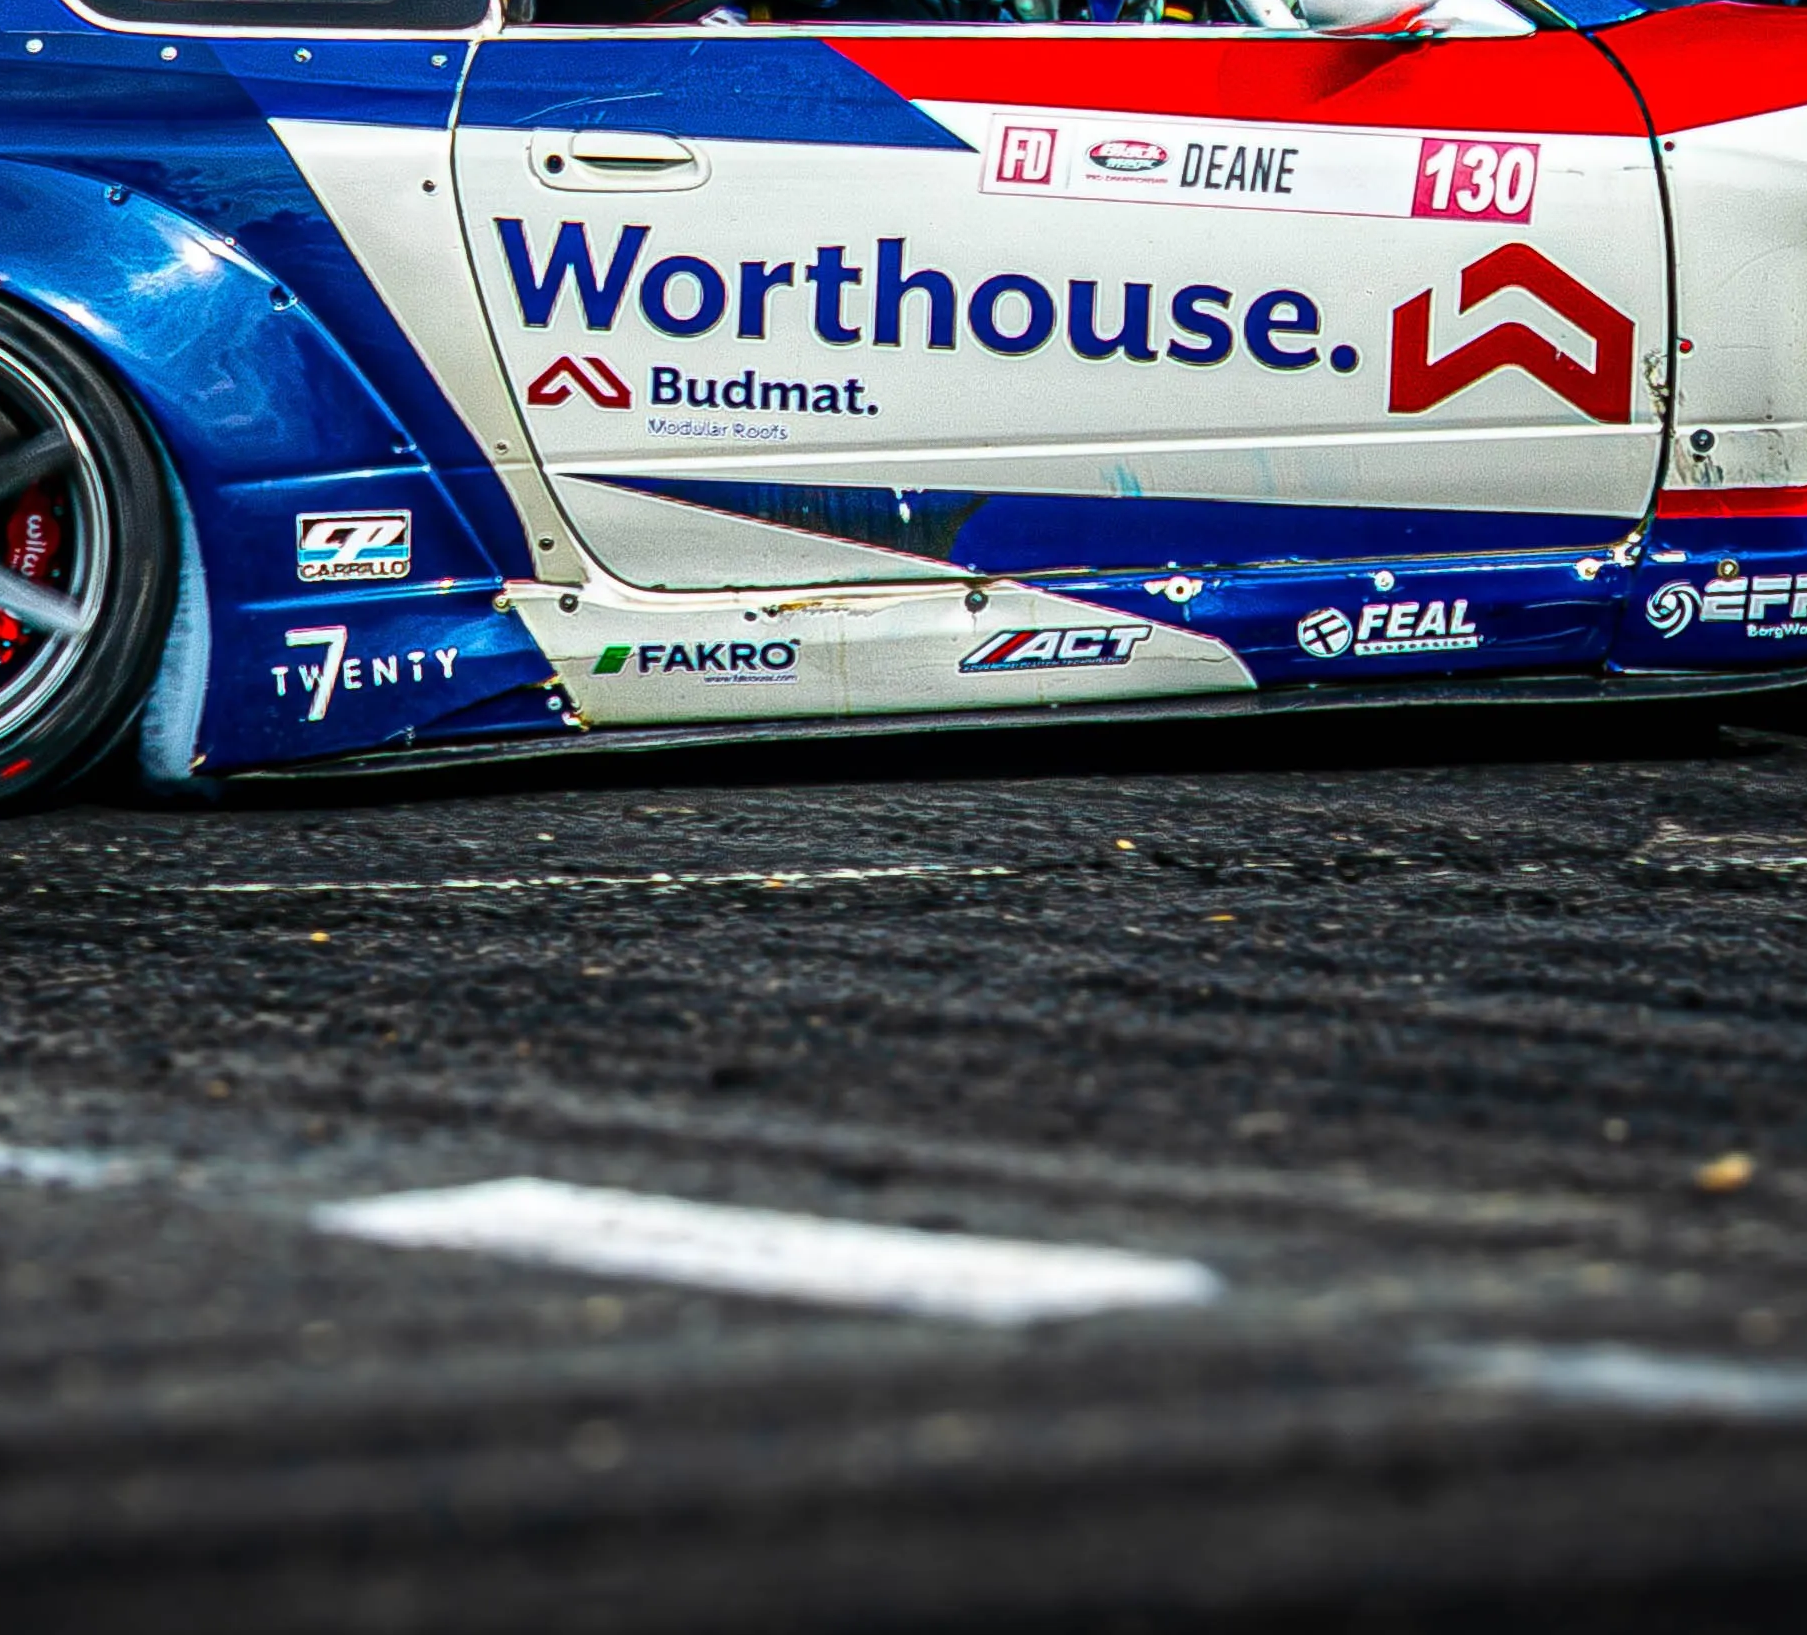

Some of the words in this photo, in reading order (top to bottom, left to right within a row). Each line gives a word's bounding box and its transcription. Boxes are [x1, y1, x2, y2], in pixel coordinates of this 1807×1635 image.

[1179, 142, 1299, 194] DEANE
[1424, 143, 1536, 216] 130
[493, 216, 1363, 376] Worthouse.
[649, 365, 880, 417] Budmat.
[647, 419, 728, 438] Modular
[732, 422, 789, 441] Roofs
[1356, 598, 1477, 641] FEAL
[638, 641, 796, 674] FAKRO
[1004, 626, 1152, 663] ACT
